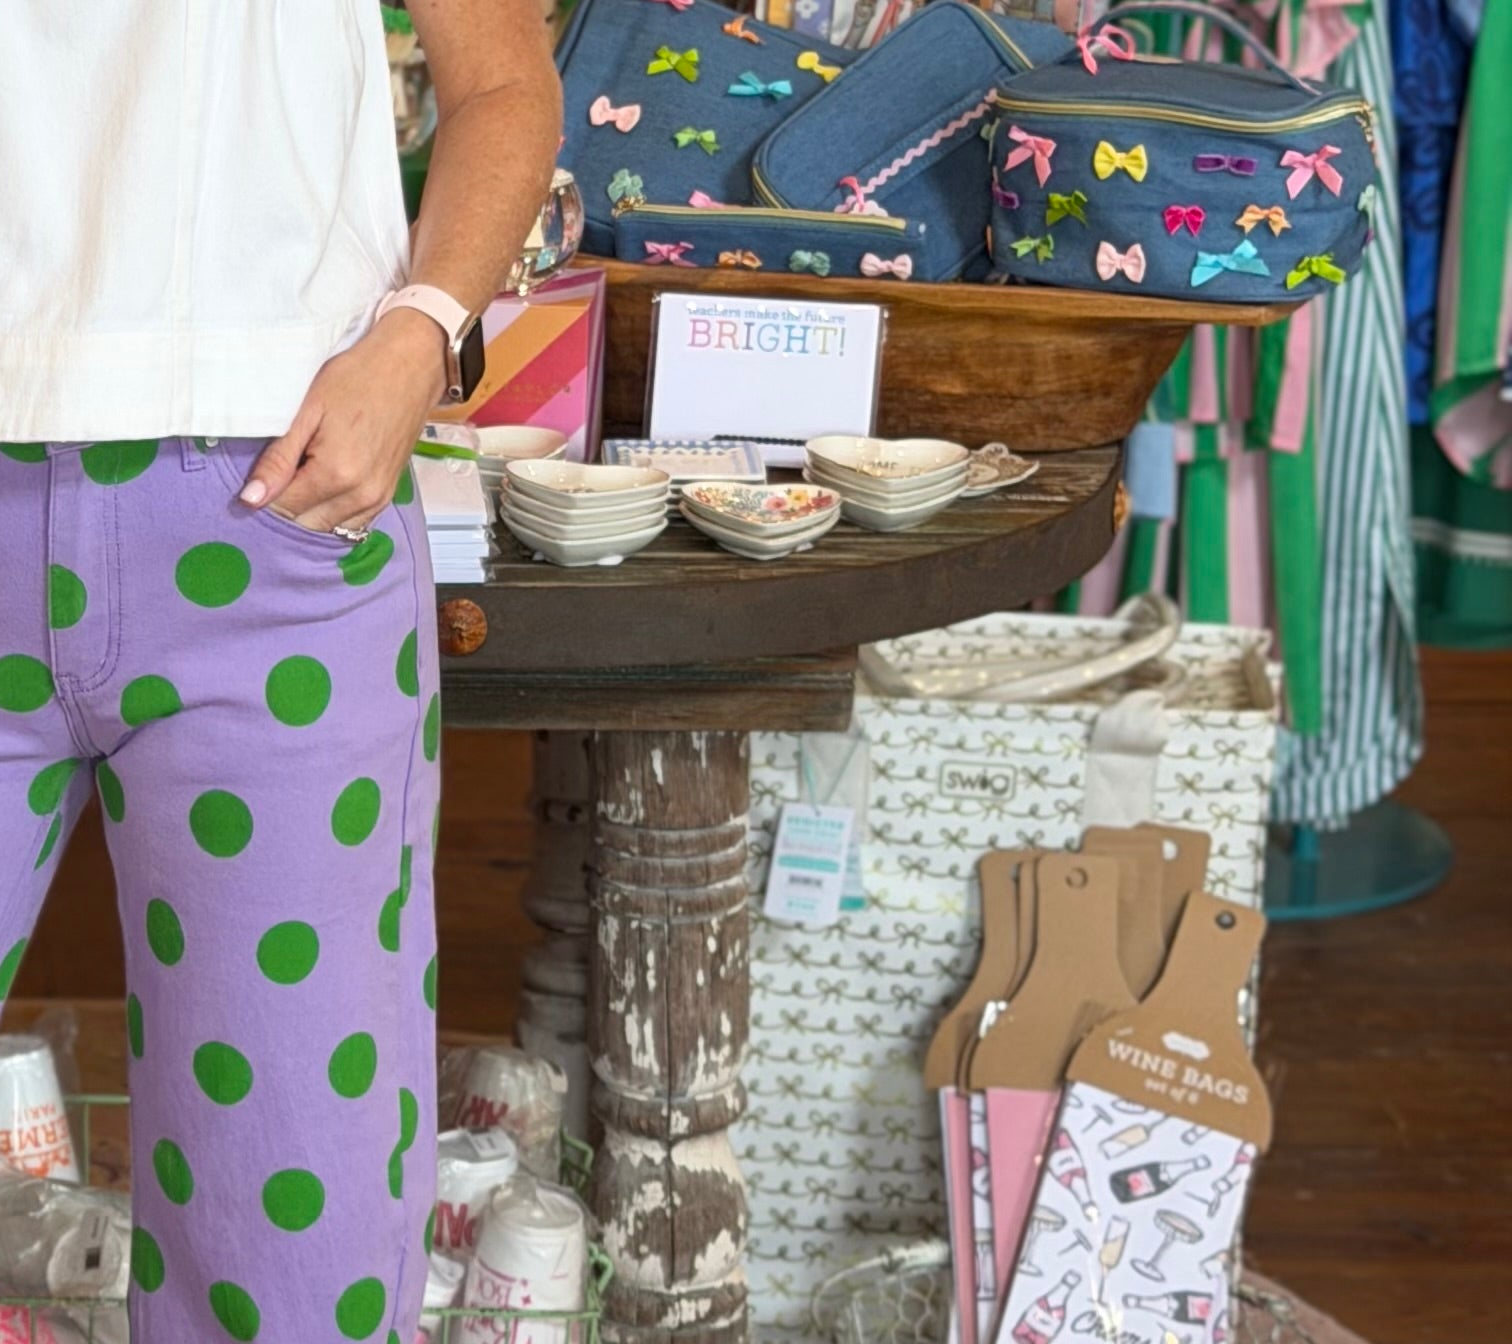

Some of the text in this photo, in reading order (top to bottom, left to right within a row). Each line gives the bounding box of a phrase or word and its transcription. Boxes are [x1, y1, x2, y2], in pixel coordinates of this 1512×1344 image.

[744, 309, 779, 321] make
[687, 318, 847, 357] BRIGHT!
[1107, 1039, 1178, 1080] WINE
[1181, 1066, 1249, 1105] BAGS
